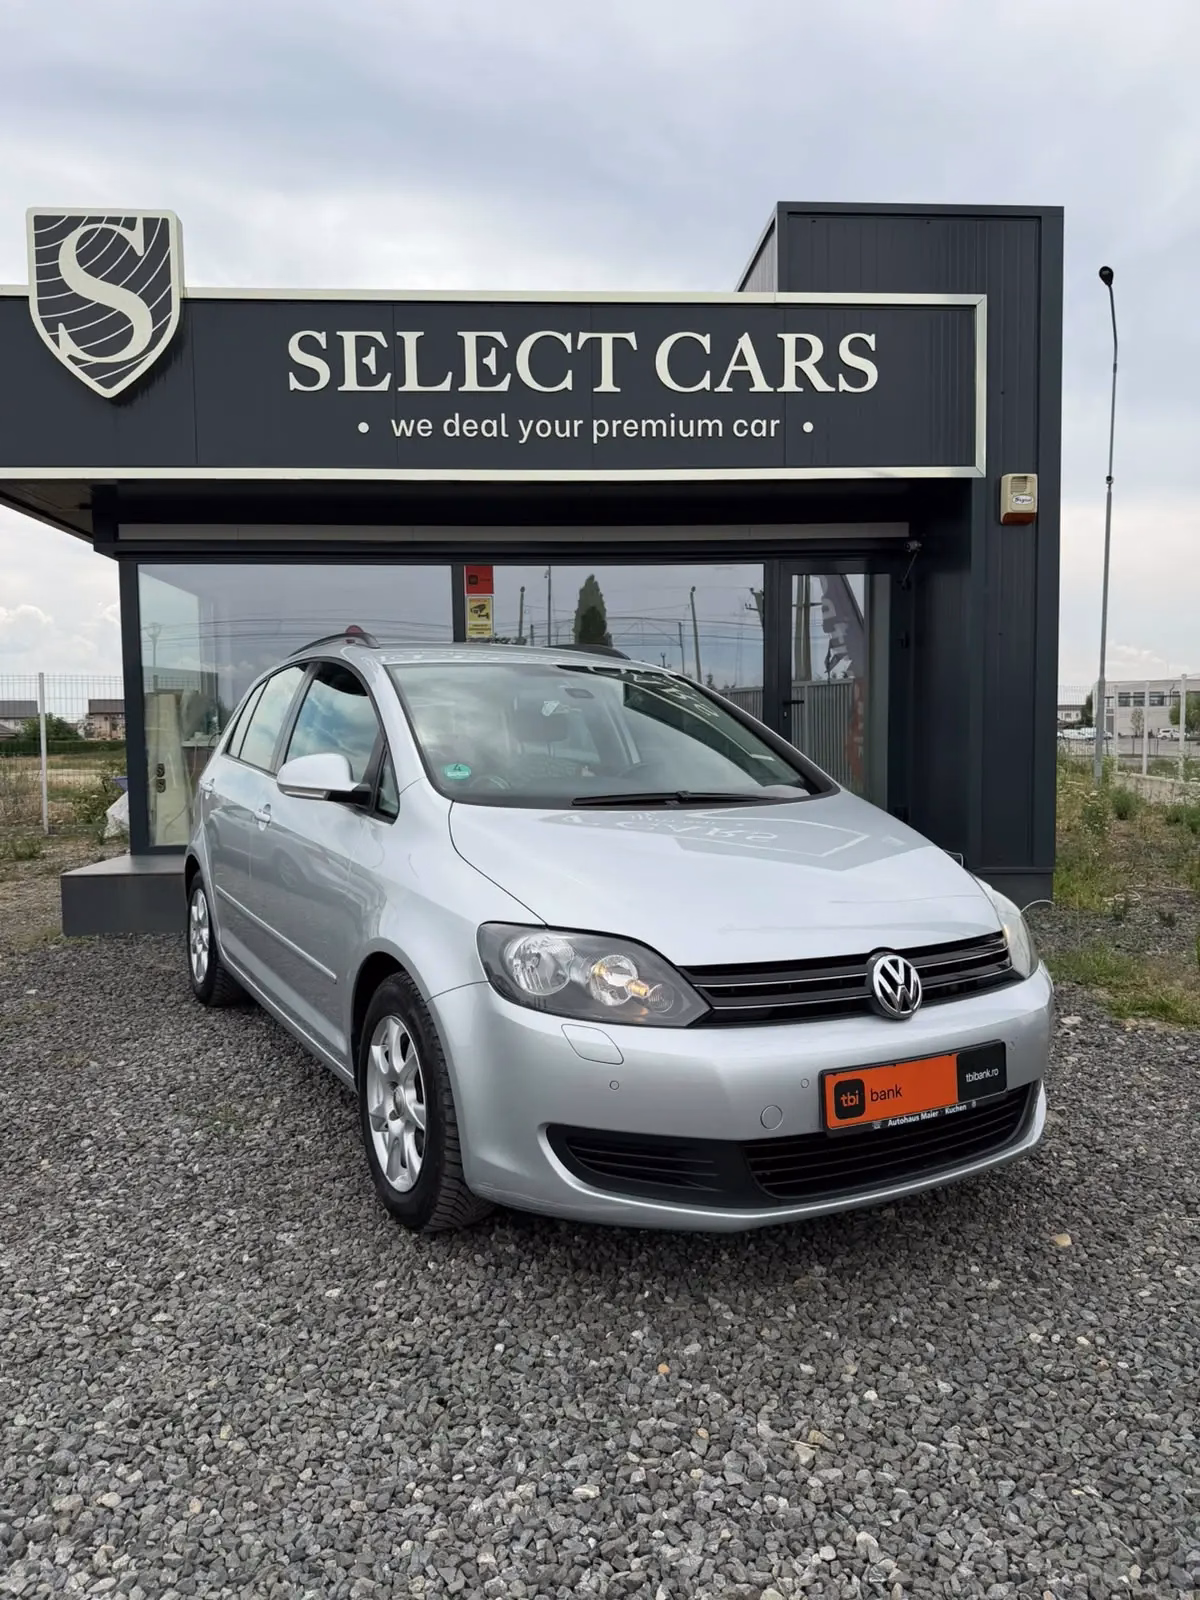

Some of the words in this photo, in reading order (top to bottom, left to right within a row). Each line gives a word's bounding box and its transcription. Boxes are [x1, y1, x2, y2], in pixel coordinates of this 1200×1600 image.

[58, 216, 153, 363] S
[287, 330, 638, 393] SELECT
[655, 331, 879, 393] CARS
[391, 418, 432, 437] we
[443, 412, 509, 438] deal
[519, 419, 584, 444] your
[593, 412, 723, 444] premium
[733, 418, 781, 438] car
[965, 1068, 999, 1083] tbibank.ro
[840, 1090, 859, 1107] tbi
[870, 1084, 902, 1102] bank
[887, 1114, 920, 1127] Autohaus
[920, 1110, 939, 1120] Maier
